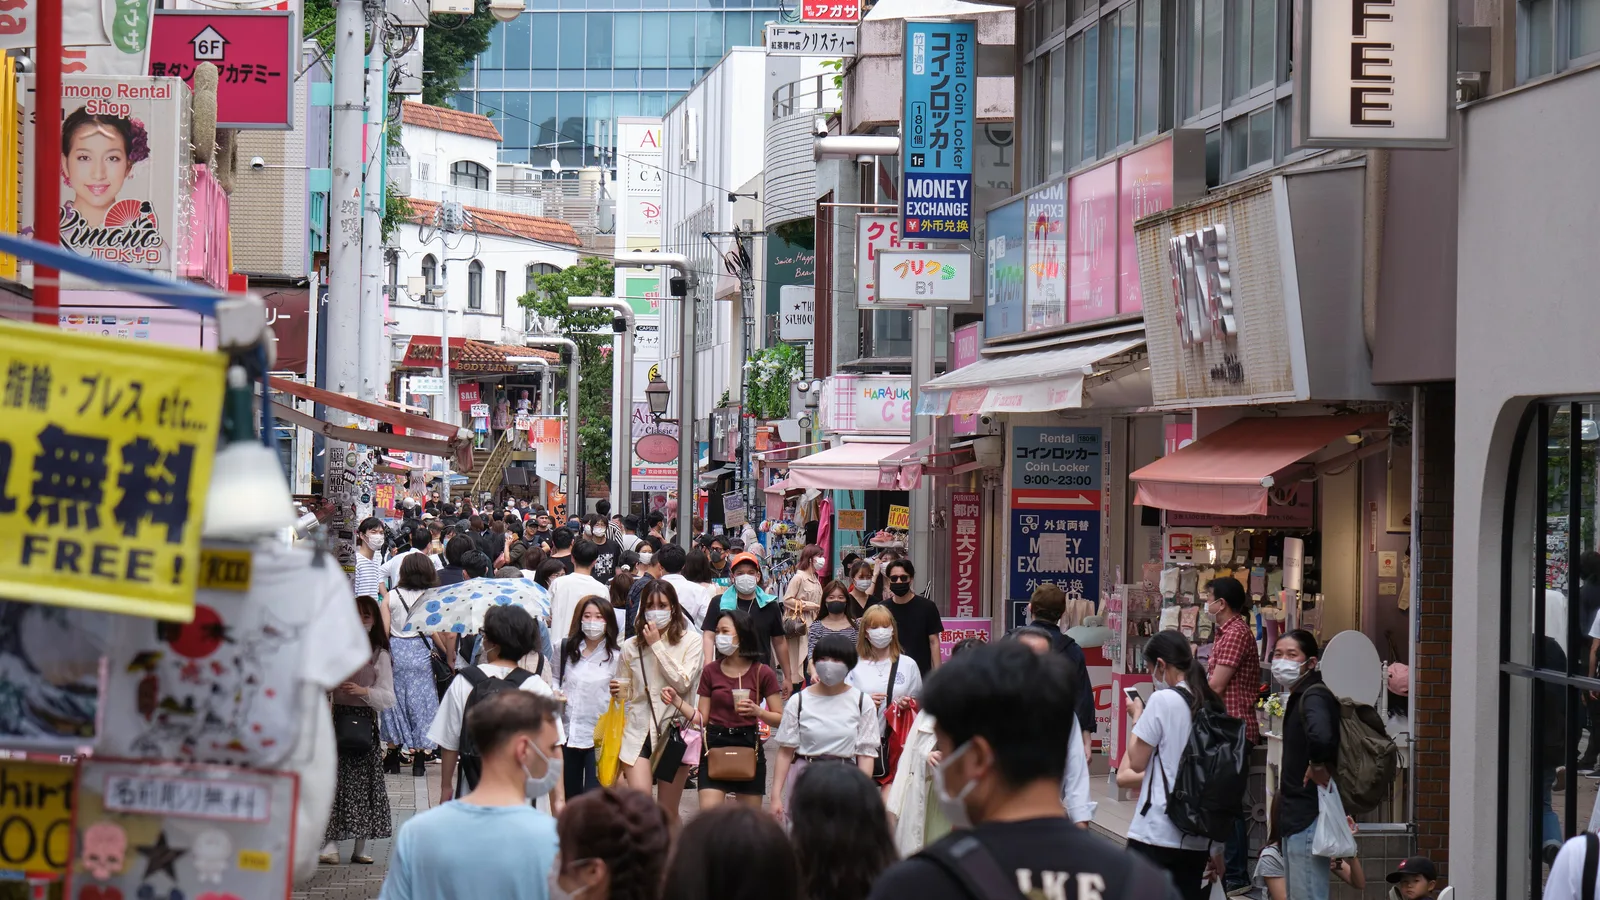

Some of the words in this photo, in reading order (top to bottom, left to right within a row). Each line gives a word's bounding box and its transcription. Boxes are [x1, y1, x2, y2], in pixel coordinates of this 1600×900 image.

[815, 4, 858, 17] アガサ
[198, 40, 220, 54] 6F
[802, 33, 855, 52] クリスティー
[914, 33, 925, 73] 竹下通り
[955, 33, 968, 78] Rental
[117, 83, 171, 98] Rental
[930, 33, 951, 168] コインロッカー
[954, 83, 967, 115] Coin
[86, 99, 130, 119] Shop
[914, 105, 924, 145] 180個
[953, 120, 967, 169] Locker
[912, 156, 924, 165] 1F
[907, 179, 968, 199] MONEY
[906, 201, 969, 216] EXCHANGE
[920, 219, 969, 232] 外币兑换
[92, 248, 161, 263] TOKYO
[916, 281, 934, 295] B1
[461, 391, 477, 400] SALE
[864, 386, 911, 400] HARAJUK
[1040, 433, 1075, 443] Rental
[1016, 447, 1099, 460] コインロッカー
[1025, 462, 1050, 471] Coin
[1052, 462, 1090, 472] Locker
[953, 504, 979, 517] 都内
[1044, 520, 1089, 531] 外貨両替
[1029, 537, 1082, 554] MEY
[956, 519, 977, 618] 最大プリクラ店
